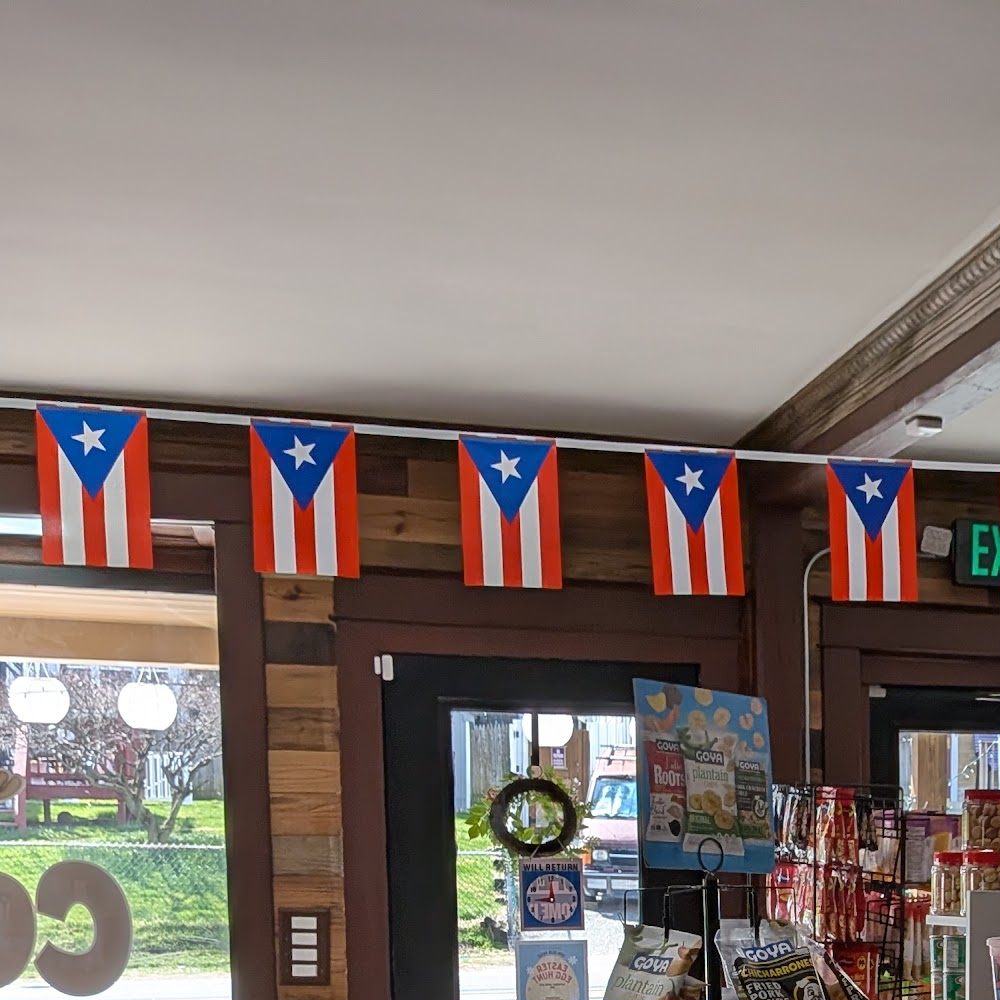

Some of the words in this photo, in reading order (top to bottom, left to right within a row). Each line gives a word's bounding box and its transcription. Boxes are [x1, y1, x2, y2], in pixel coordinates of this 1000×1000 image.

[657, 740, 680, 751] GOYA
[695, 750, 723, 763] GOYA
[739, 761, 760, 771] GOYA
[692, 767, 728, 782] plantain
[523, 863, 544, 871] WILL
[545, 863, 578, 871] RETURN
[745, 941, 793, 962] GOYA
[633, 955, 670, 973] GOYA
[741, 957, 814, 979] CHICHARRONES
[613, 973, 663, 998] plantain
[746, 980, 782, 995] FRIED
